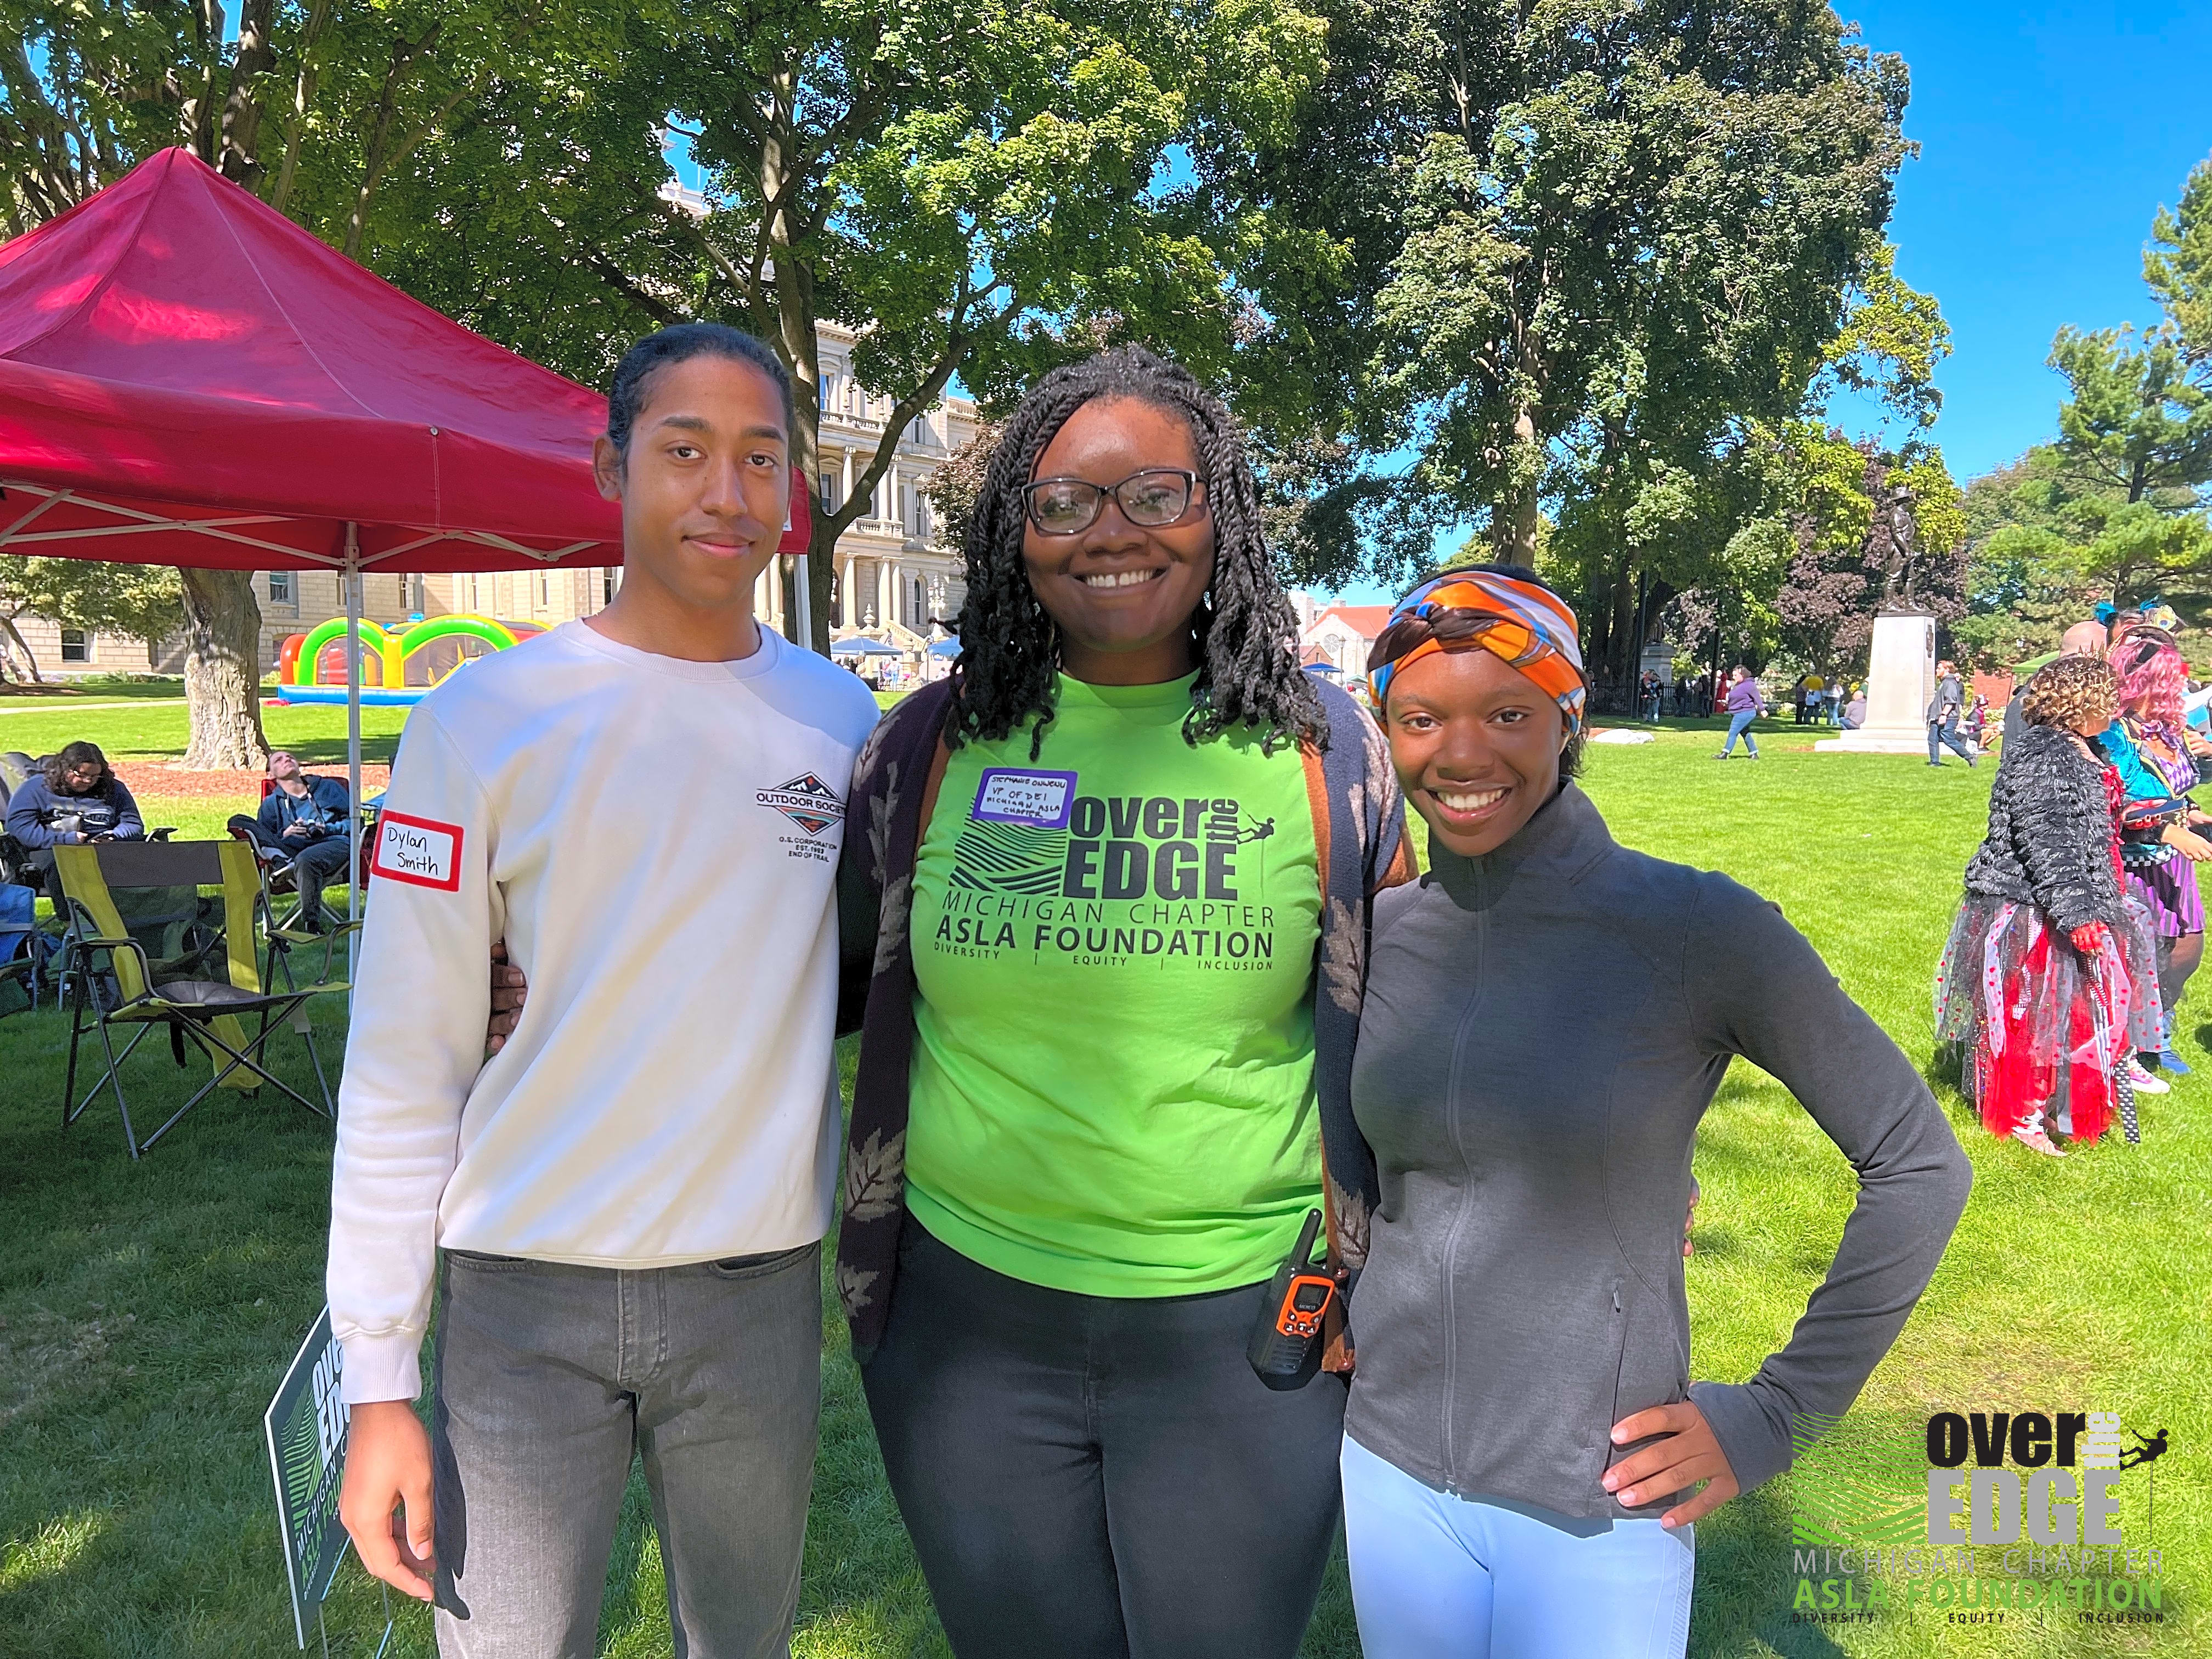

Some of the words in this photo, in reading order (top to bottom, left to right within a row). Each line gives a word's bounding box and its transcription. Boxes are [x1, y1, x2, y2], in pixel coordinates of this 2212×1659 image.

[757, 793, 813, 807] OUTDOOR
[993, 787, 1004, 795] VP
[1009, 791, 1022, 799] OF
[1003, 807, 1042, 817] CHAPTER
[1070, 797, 1208, 839] over
[1204, 799, 1239, 841] the
[387, 827, 427, 853] Dylan
[397, 852, 438, 876] Smith
[1063, 839, 1238, 901] EDGE
[942, 890, 1103, 923] MICHIGAN
[1130, 904, 1273, 927] CHAPTER
[936, 914, 1015, 949] ASLA
[1034, 924, 1272, 958] FOUNDATION
[934, 941, 1000, 960] DIVERSITY
[1073, 955, 1127, 966] EQUITY
[1198, 960, 1273, 970] INCLUSION
[312, 1334, 343, 1410] ove
[297, 1455, 336, 1561] MICHIGAN
[302, 1521, 322, 1589] ASLA
